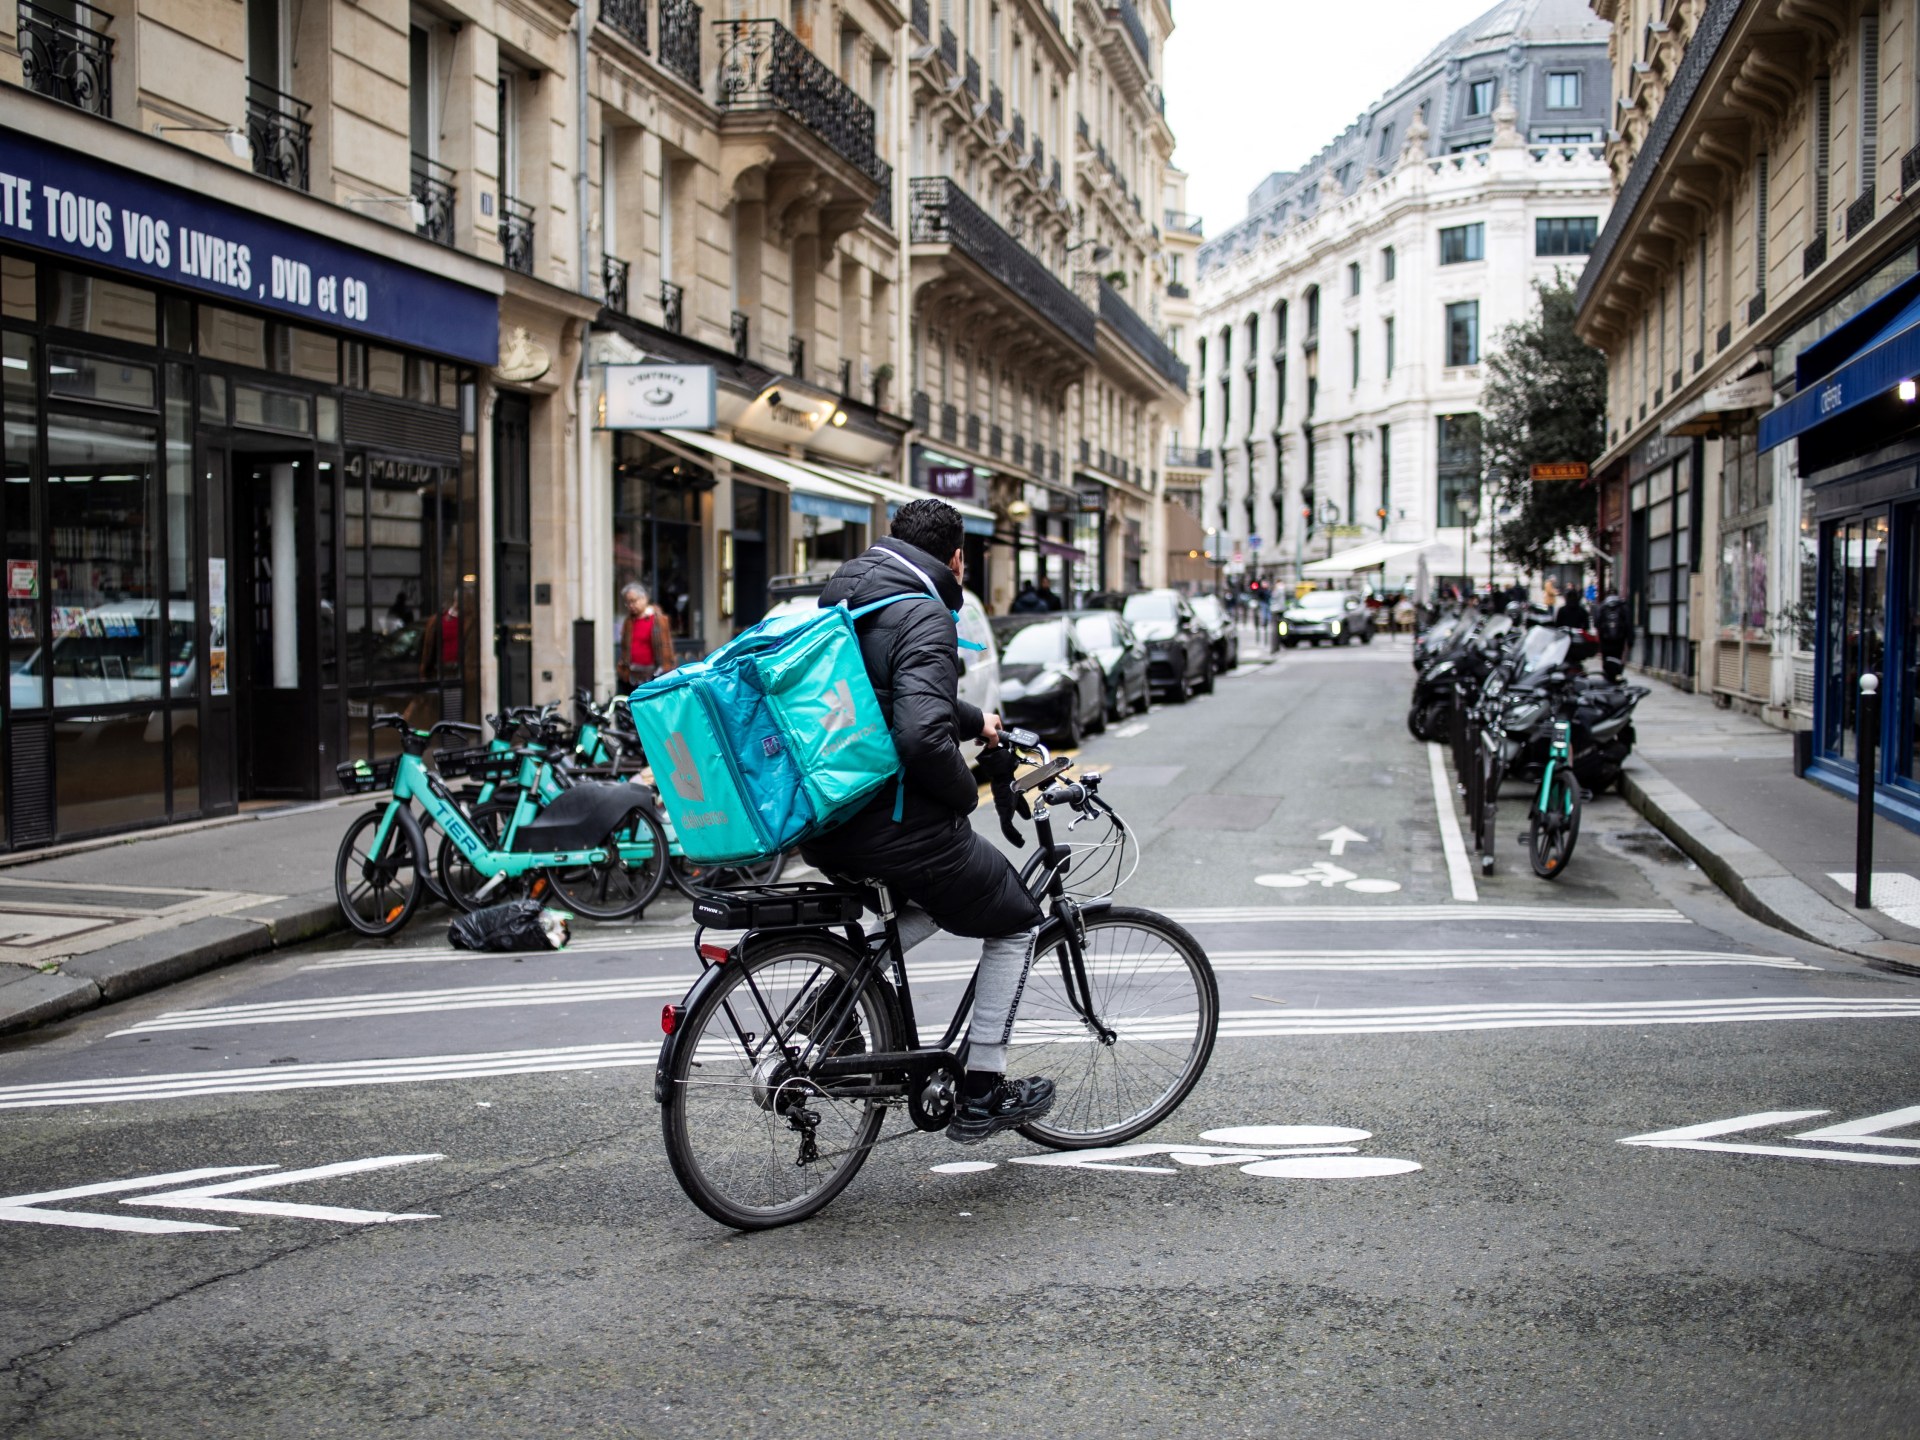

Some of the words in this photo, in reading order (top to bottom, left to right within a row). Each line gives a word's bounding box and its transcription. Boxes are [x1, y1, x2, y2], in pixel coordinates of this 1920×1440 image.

[0, 172, 32, 231] TE
[43, 185, 113, 252] TOUS
[122, 209, 171, 268] VOS
[180, 227, 252, 291] LIVRES
[272, 254, 312, 307] DVD
[318, 275, 338, 314] et
[343, 277, 368, 322] CD
[436, 801, 477, 855] TIER
[681, 809, 729, 830] deliveroo
